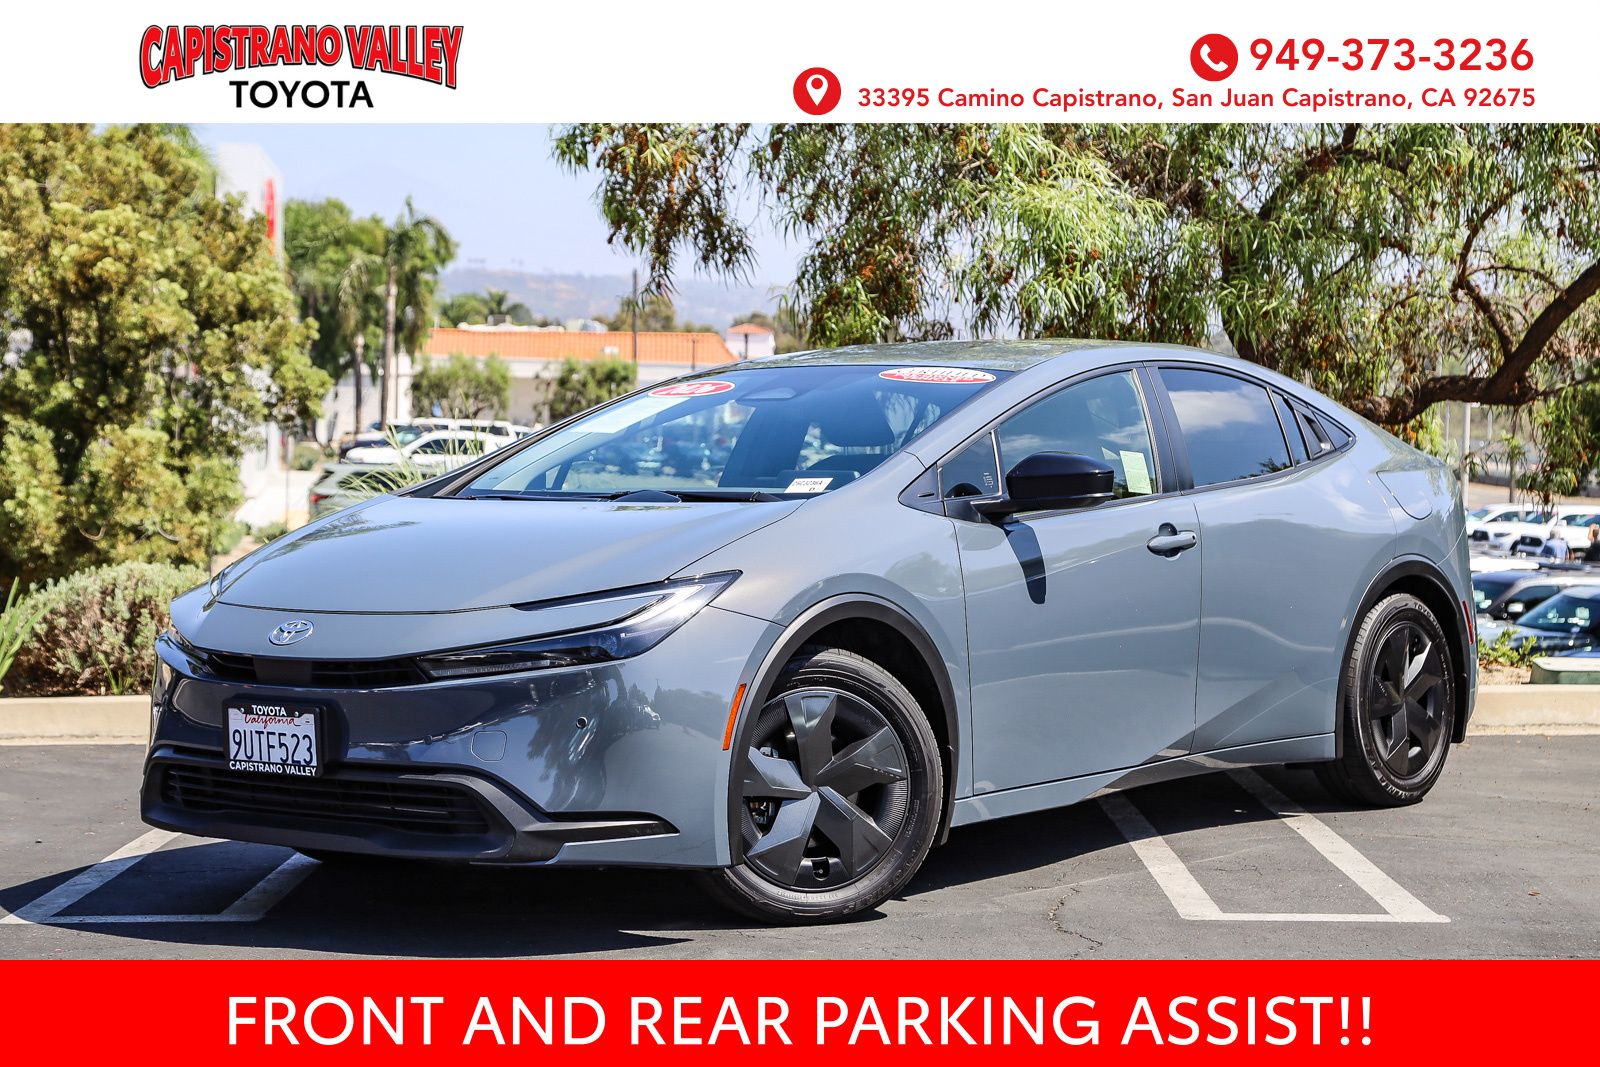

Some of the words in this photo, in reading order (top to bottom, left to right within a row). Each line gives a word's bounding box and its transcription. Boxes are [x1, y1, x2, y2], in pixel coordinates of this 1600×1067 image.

[251, 704, 287, 717] TOYOTA
[244, 713, 301, 729] California
[232, 728, 314, 765] 9UTF523
[229, 760, 283, 774] CAPISTRANO
[284, 764, 317, 777] VALLEY
